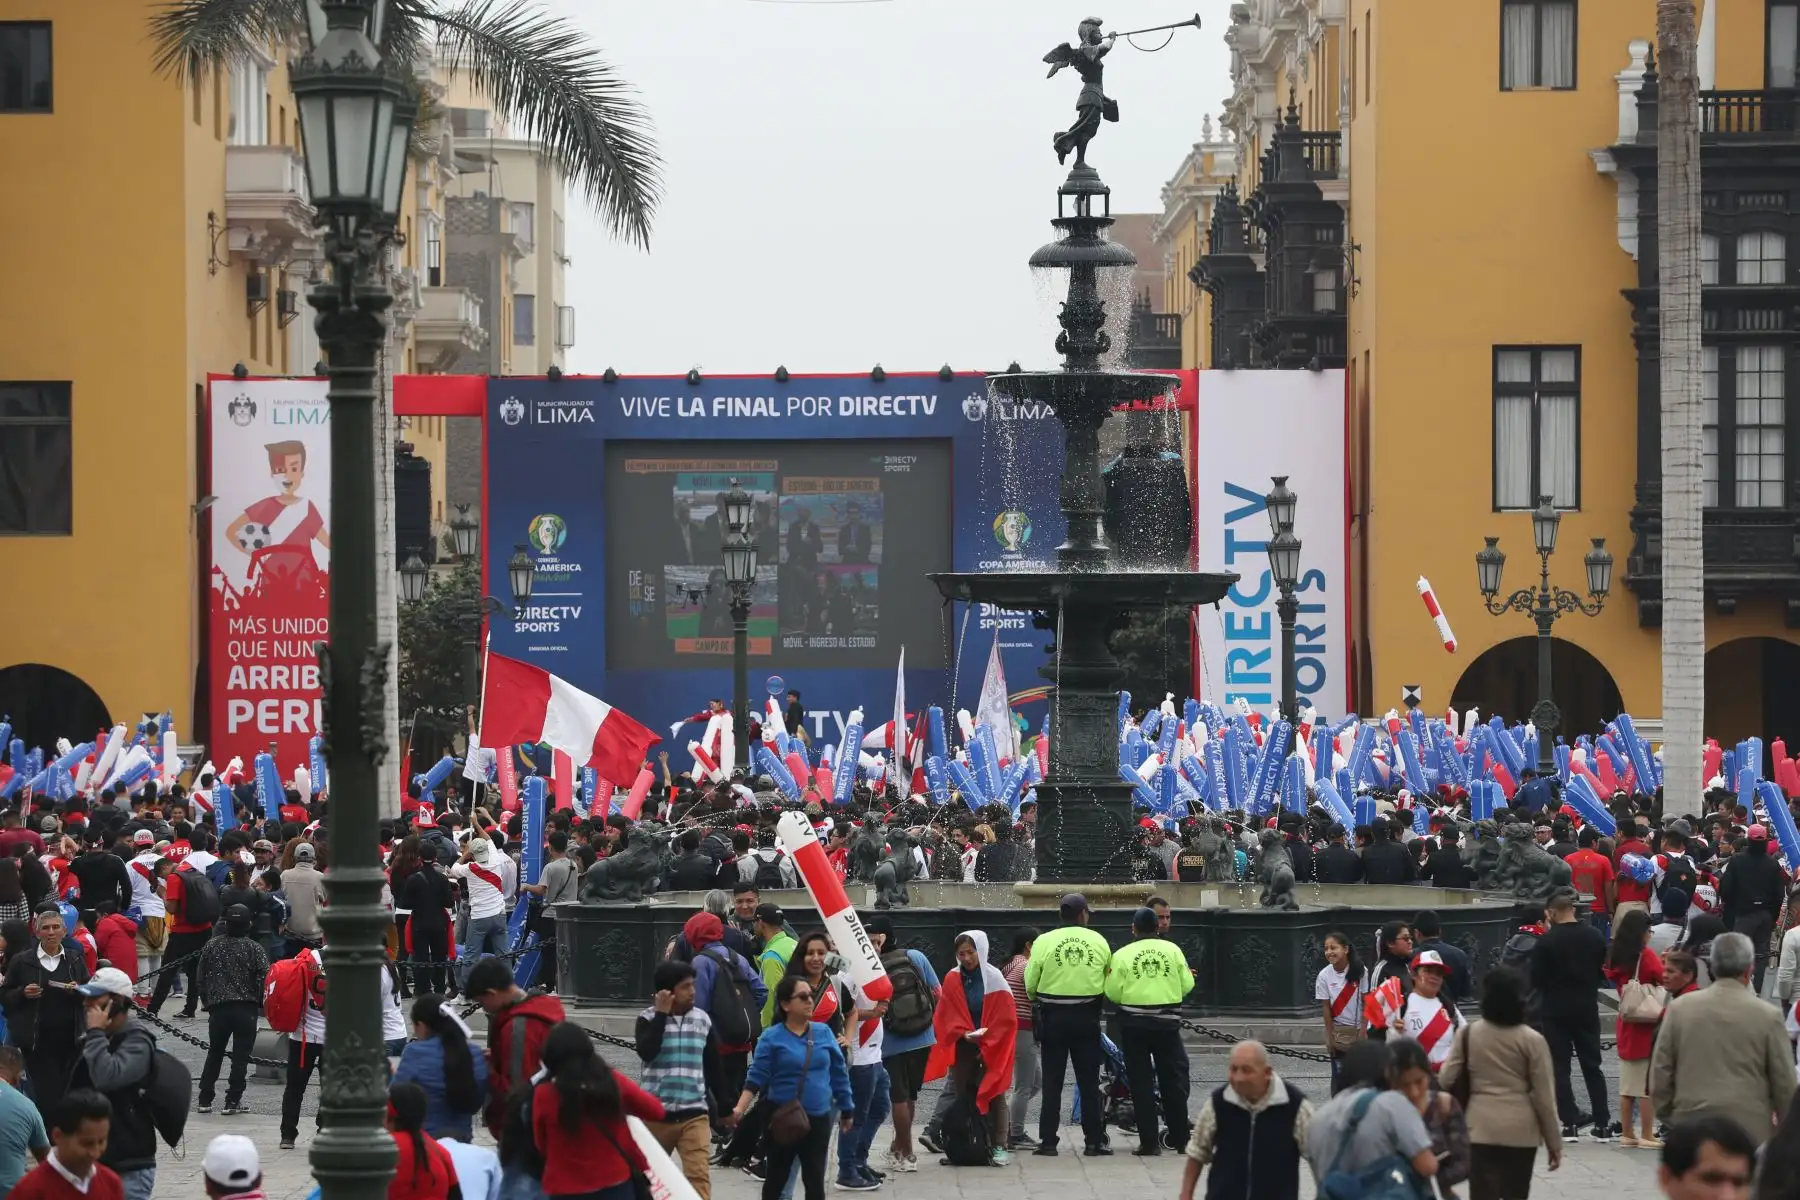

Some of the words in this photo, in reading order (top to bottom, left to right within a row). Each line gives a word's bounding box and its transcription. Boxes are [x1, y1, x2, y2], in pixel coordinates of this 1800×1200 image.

[537, 407, 595, 424] LIMA
[620, 396, 671, 417] VIVE
[677, 396, 706, 417] LA
[712, 396, 782, 417] FINAL
[787, 396, 832, 416] POR
[839, 395, 937, 416] DIRECTV
[1000, 404, 1055, 420] LIMA
[540, 563, 582, 572] AMERICA
[978, 560, 1004, 569] COPA
[1005, 560, 1047, 569] AMERICA
[628, 570, 643, 586] DE
[644, 587, 656, 601] SE
[1224, 481, 1272, 706] IRECTV
[514, 606, 582, 619] DIRECTV
[979, 618, 1026, 629] SPORTS
[228, 615, 267, 635] MÁS
[272, 617, 329, 635] UNIDO
[514, 622, 560, 633] SPORTS
[228, 640, 268, 661] QUE
[273, 640, 328, 657] NUN
[809, 637, 838, 648] INGRESO
[839, 637, 847, 647] AL
[848, 637, 876, 648] ESTADIO
[227, 665, 323, 690] ARRIB
[843, 729, 858, 762] DIRECTV
[1272, 723, 1289, 755] DIREC
[760, 757, 787, 788] DIRECTV
[835, 766, 850, 799] DIRECTV
[1212, 759, 1227, 790] DIRECTV
[1260, 758, 1279, 802] DIRECTV
[255, 765, 268, 811] DIRECT
[1248, 766, 1263, 804] DIRECTV
[213, 784, 226, 830] DIRECTV
[1320, 793, 1343, 824] DIRECTV
[521, 802, 530, 855] DIRECTV
[844, 910, 883, 972] DIRECTV
[1054, 937, 1080, 967] SERENAZGO
[1081, 940, 1090, 949] DE
[1085, 949, 1094, 967] LIMA
[1132, 949, 1156, 980] SERENAZGO
[1157, 950, 1167, 960] DE
[1410, 1018, 1423, 1031] 20
